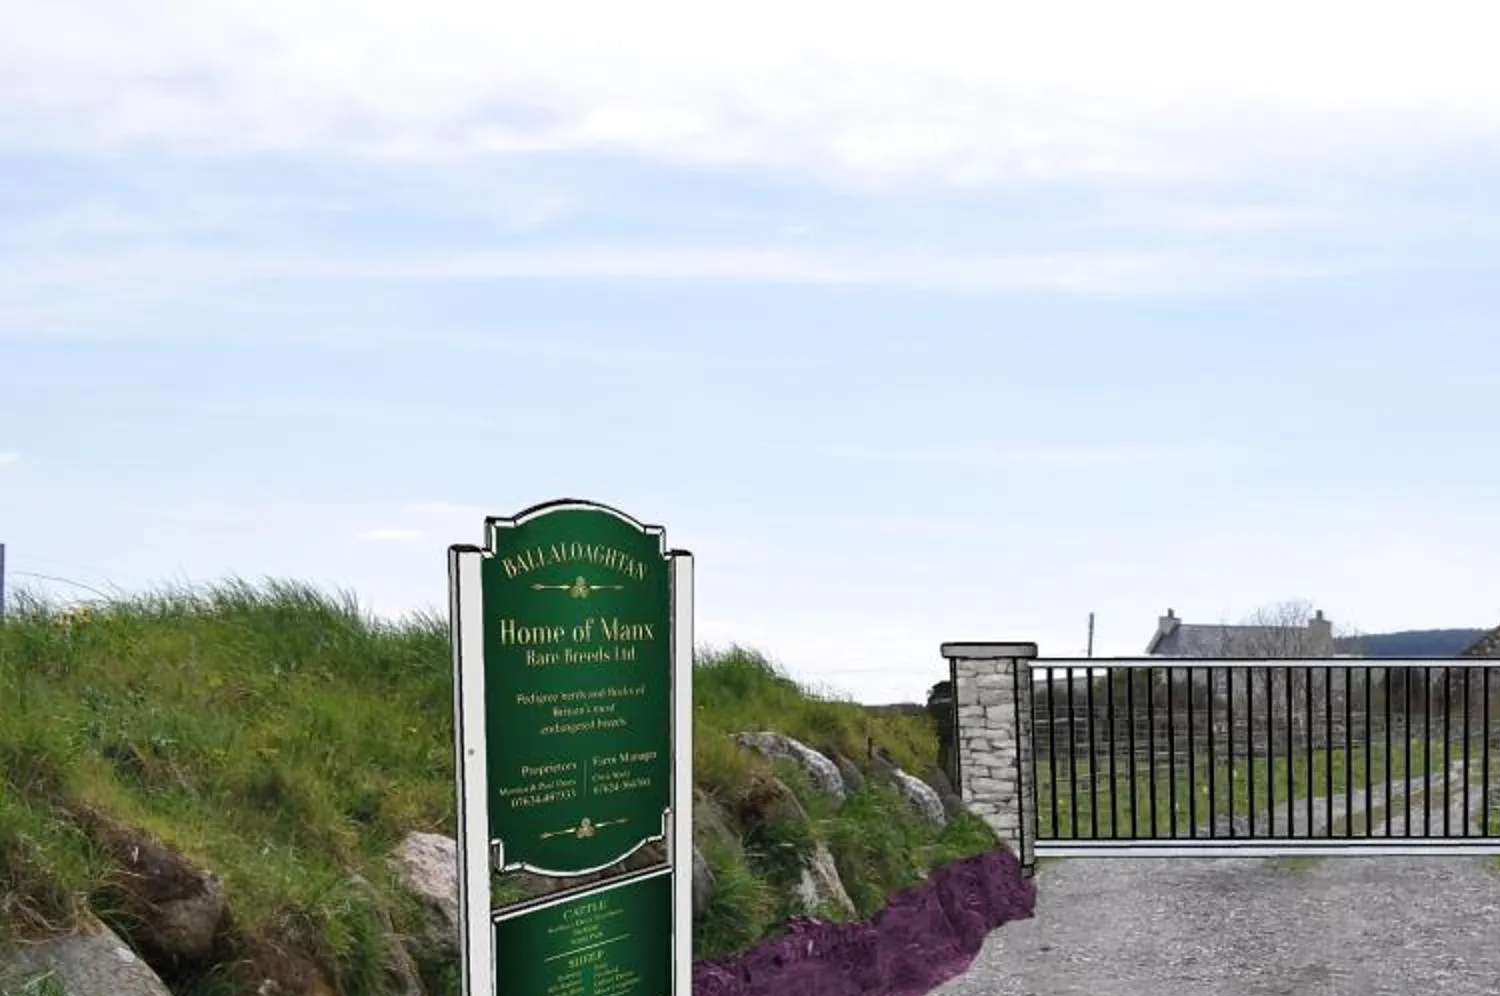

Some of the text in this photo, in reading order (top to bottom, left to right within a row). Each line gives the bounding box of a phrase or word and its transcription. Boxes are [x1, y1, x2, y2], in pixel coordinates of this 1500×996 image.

[500, 616, 655, 645] Home of Manx
[527, 645, 636, 667] Rare Breeds Ltd
